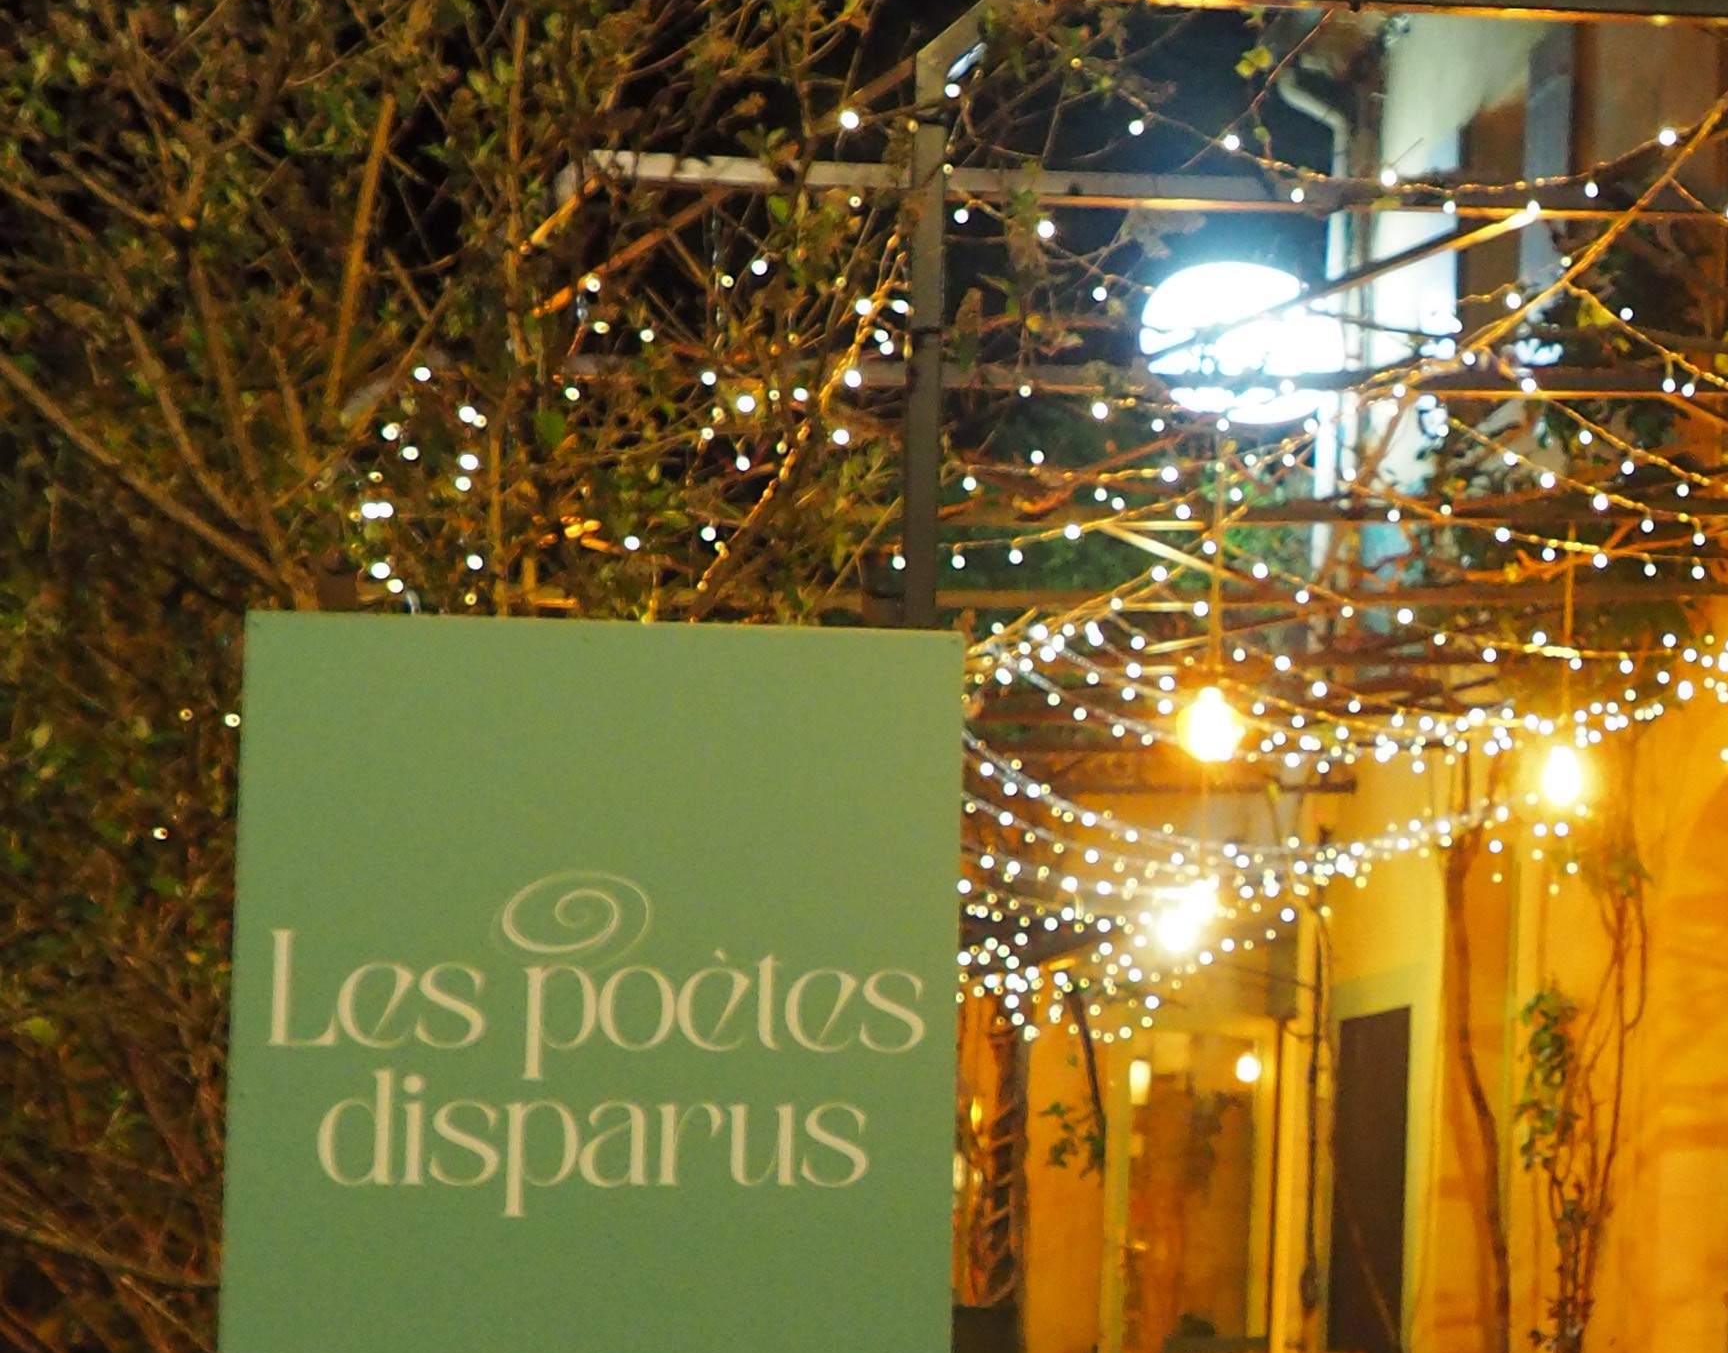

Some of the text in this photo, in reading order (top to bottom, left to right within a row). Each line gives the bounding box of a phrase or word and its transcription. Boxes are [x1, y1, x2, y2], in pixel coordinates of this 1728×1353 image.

[269, 927, 928, 1081] Les poètes
[315, 1067, 870, 1219] disparus
